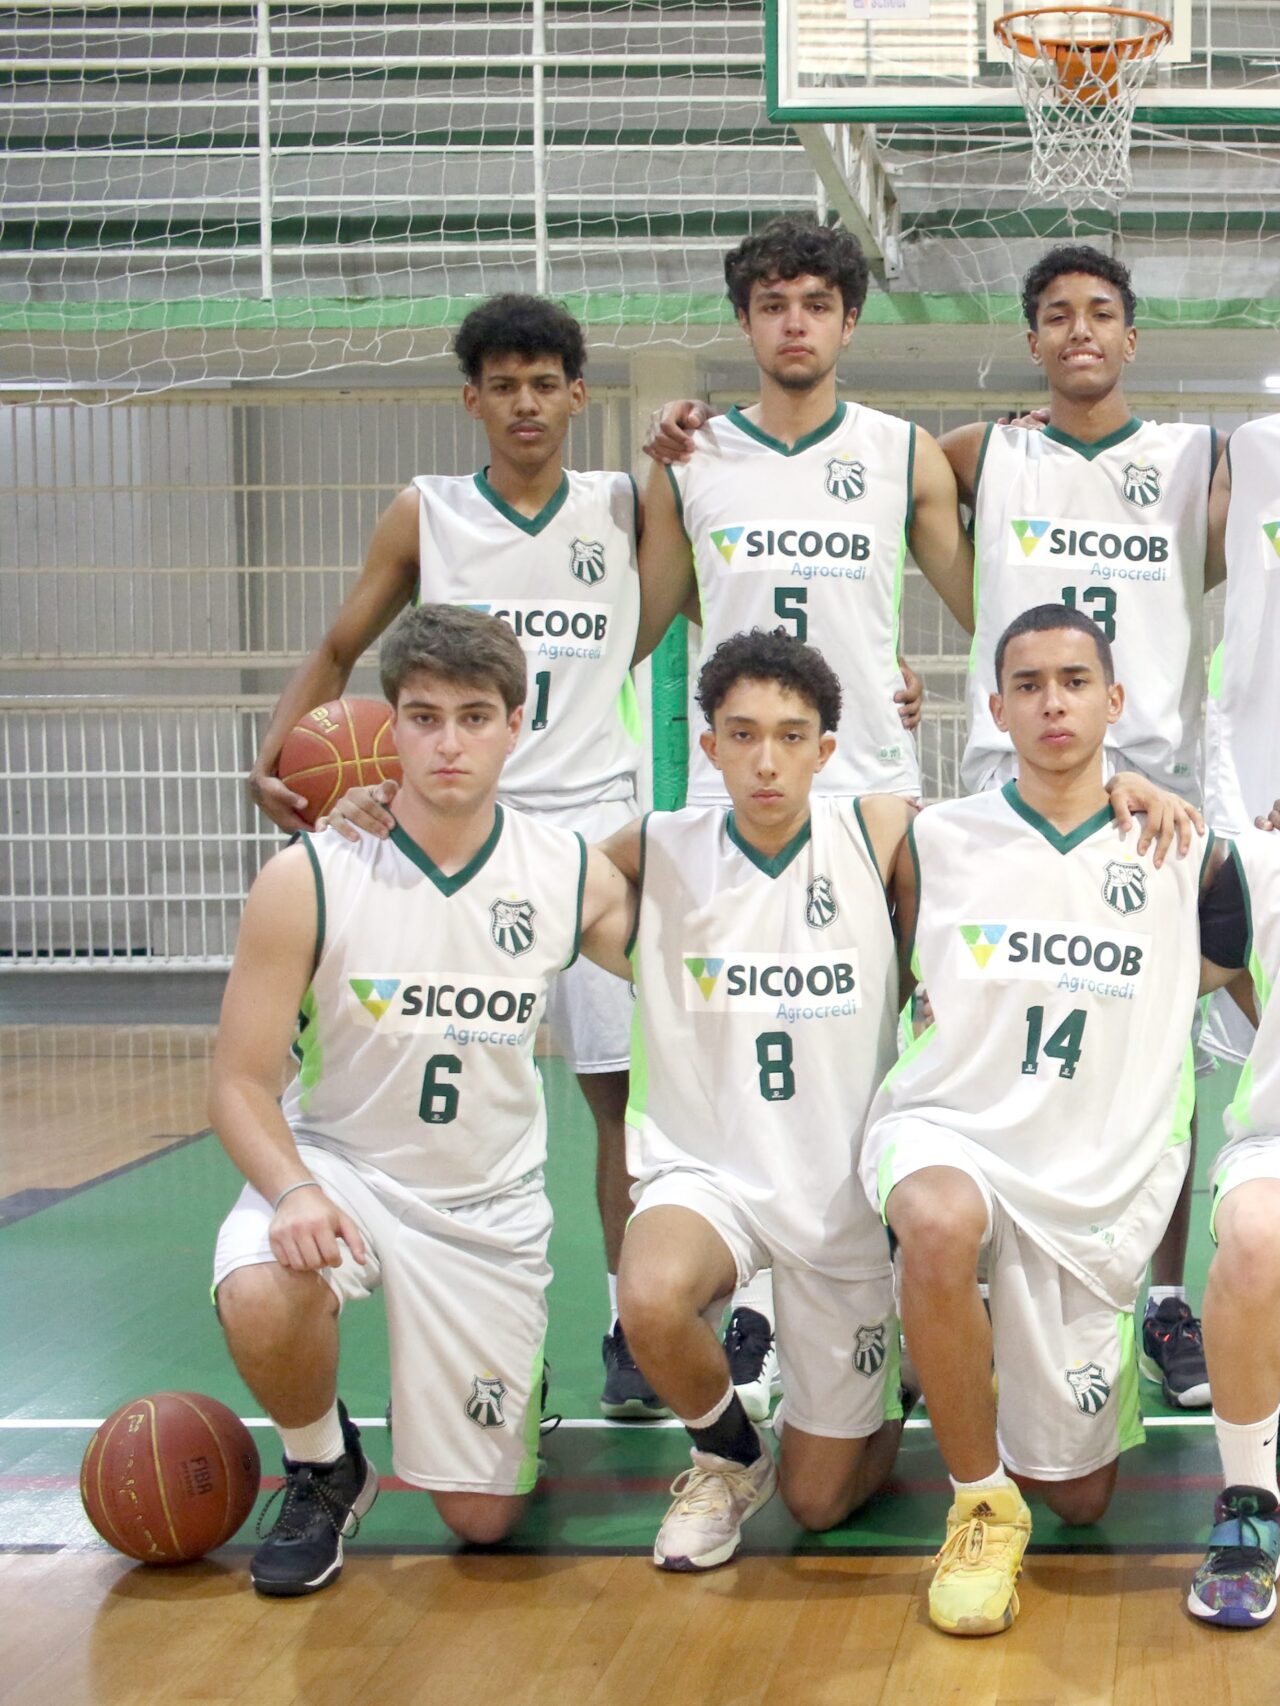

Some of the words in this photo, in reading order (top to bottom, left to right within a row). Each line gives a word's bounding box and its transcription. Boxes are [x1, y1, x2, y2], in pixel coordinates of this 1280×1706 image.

[746, 530, 870, 561] SICOOB
[1049, 528, 1168, 563] SICOOB
[790, 563, 866, 581] Agrocredi
[1091, 563, 1166, 582] Agrocredi
[773, 588, 807, 644] 5
[1008, 931, 1142, 977] SICOOB
[726, 962, 855, 997] SICOOB
[1057, 973, 1133, 999] Agrocredi
[401, 984, 535, 1023] SICOOB
[775, 1002, 856, 1023] Agrocredi
[1020, 1006, 1087, 1079] 14
[755, 1032, 795, 1101] 8
[418, 1054, 462, 1123] 6
